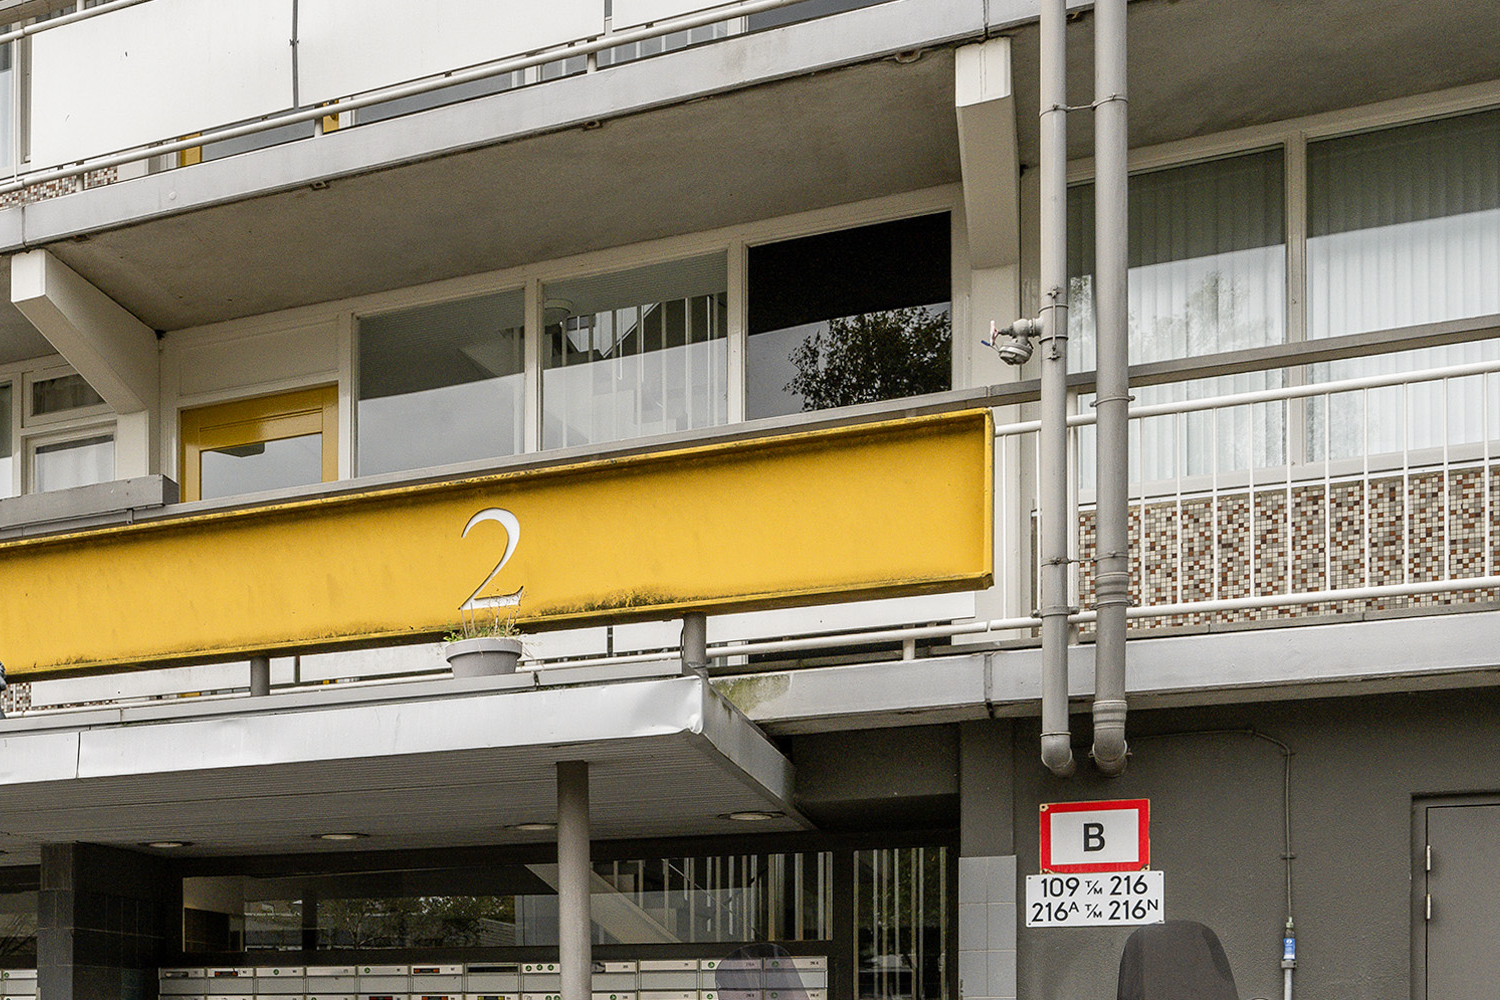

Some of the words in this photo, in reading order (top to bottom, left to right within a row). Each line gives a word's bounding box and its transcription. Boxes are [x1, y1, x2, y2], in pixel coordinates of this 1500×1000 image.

[458, 507, 524, 610] 2
[1083, 822, 1105, 852] B
[1040, 877, 1080, 897] 109
[1109, 875, 1148, 896] 216
[1031, 901, 1080, 922] 216A
[1108, 899, 1159, 921] 216N
